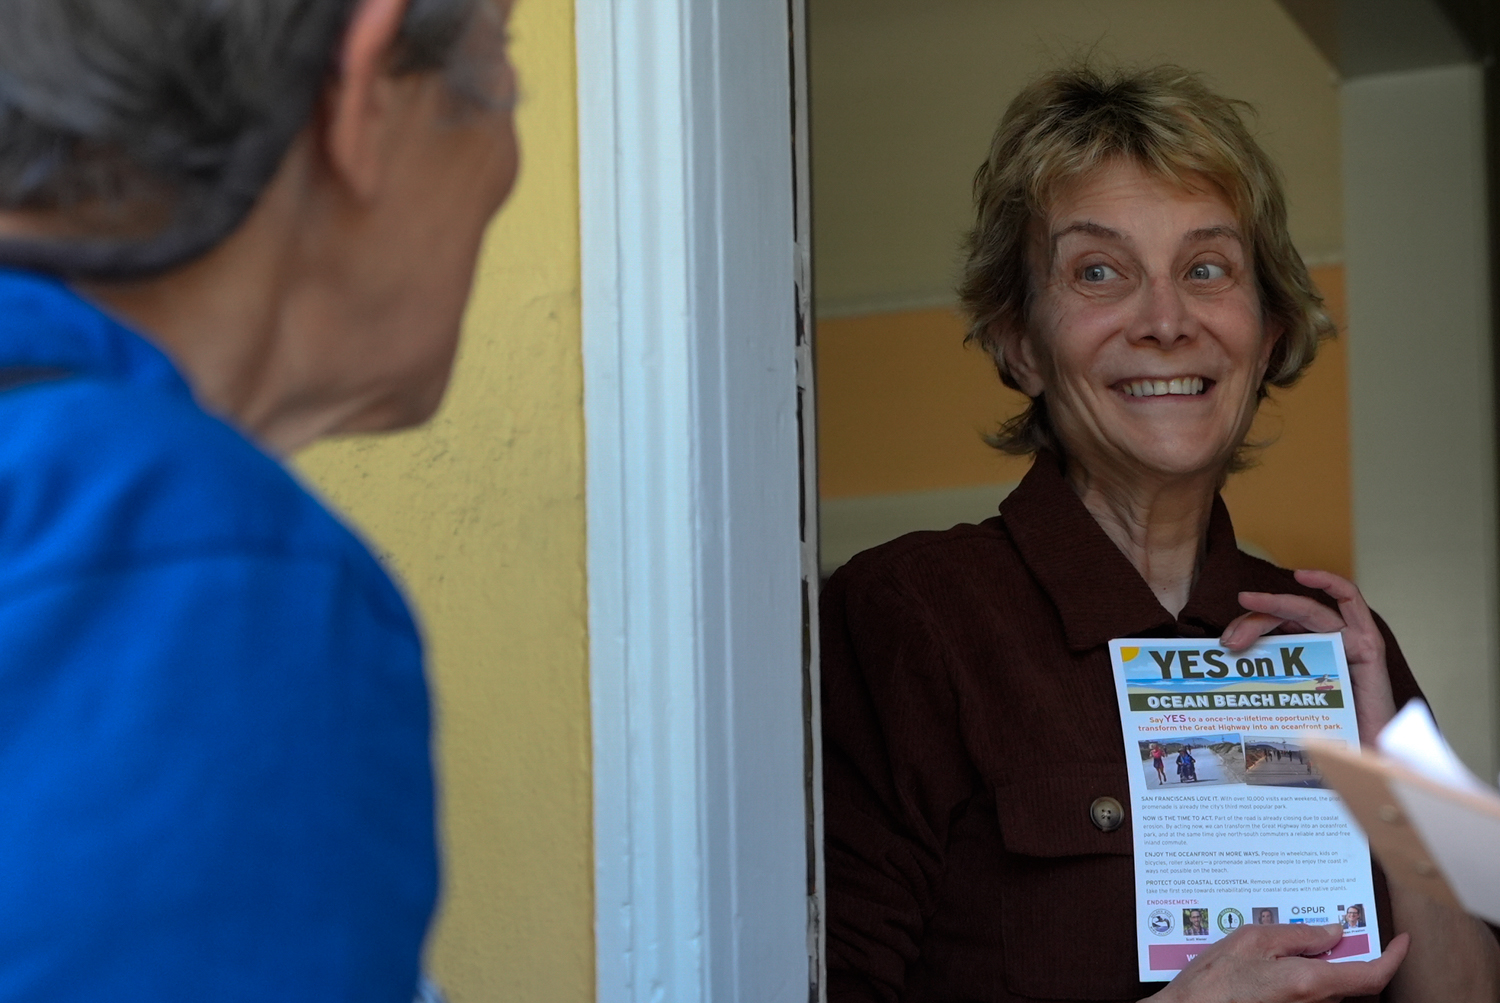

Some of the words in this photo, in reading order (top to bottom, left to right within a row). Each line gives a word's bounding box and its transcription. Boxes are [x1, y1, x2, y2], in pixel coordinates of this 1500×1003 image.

[1148, 649, 1229, 679] YES
[1236, 657, 1275, 678] on
[1280, 646, 1311, 677] K
[1147, 695, 1210, 709] OCEAN
[1213, 693, 1274, 708] BEACH
[1279, 692, 1329, 707] PARK
[1164, 714, 1186, 723] YES
[1324, 723, 1343, 731] park.
[1301, 906, 1325, 914] SPUR
